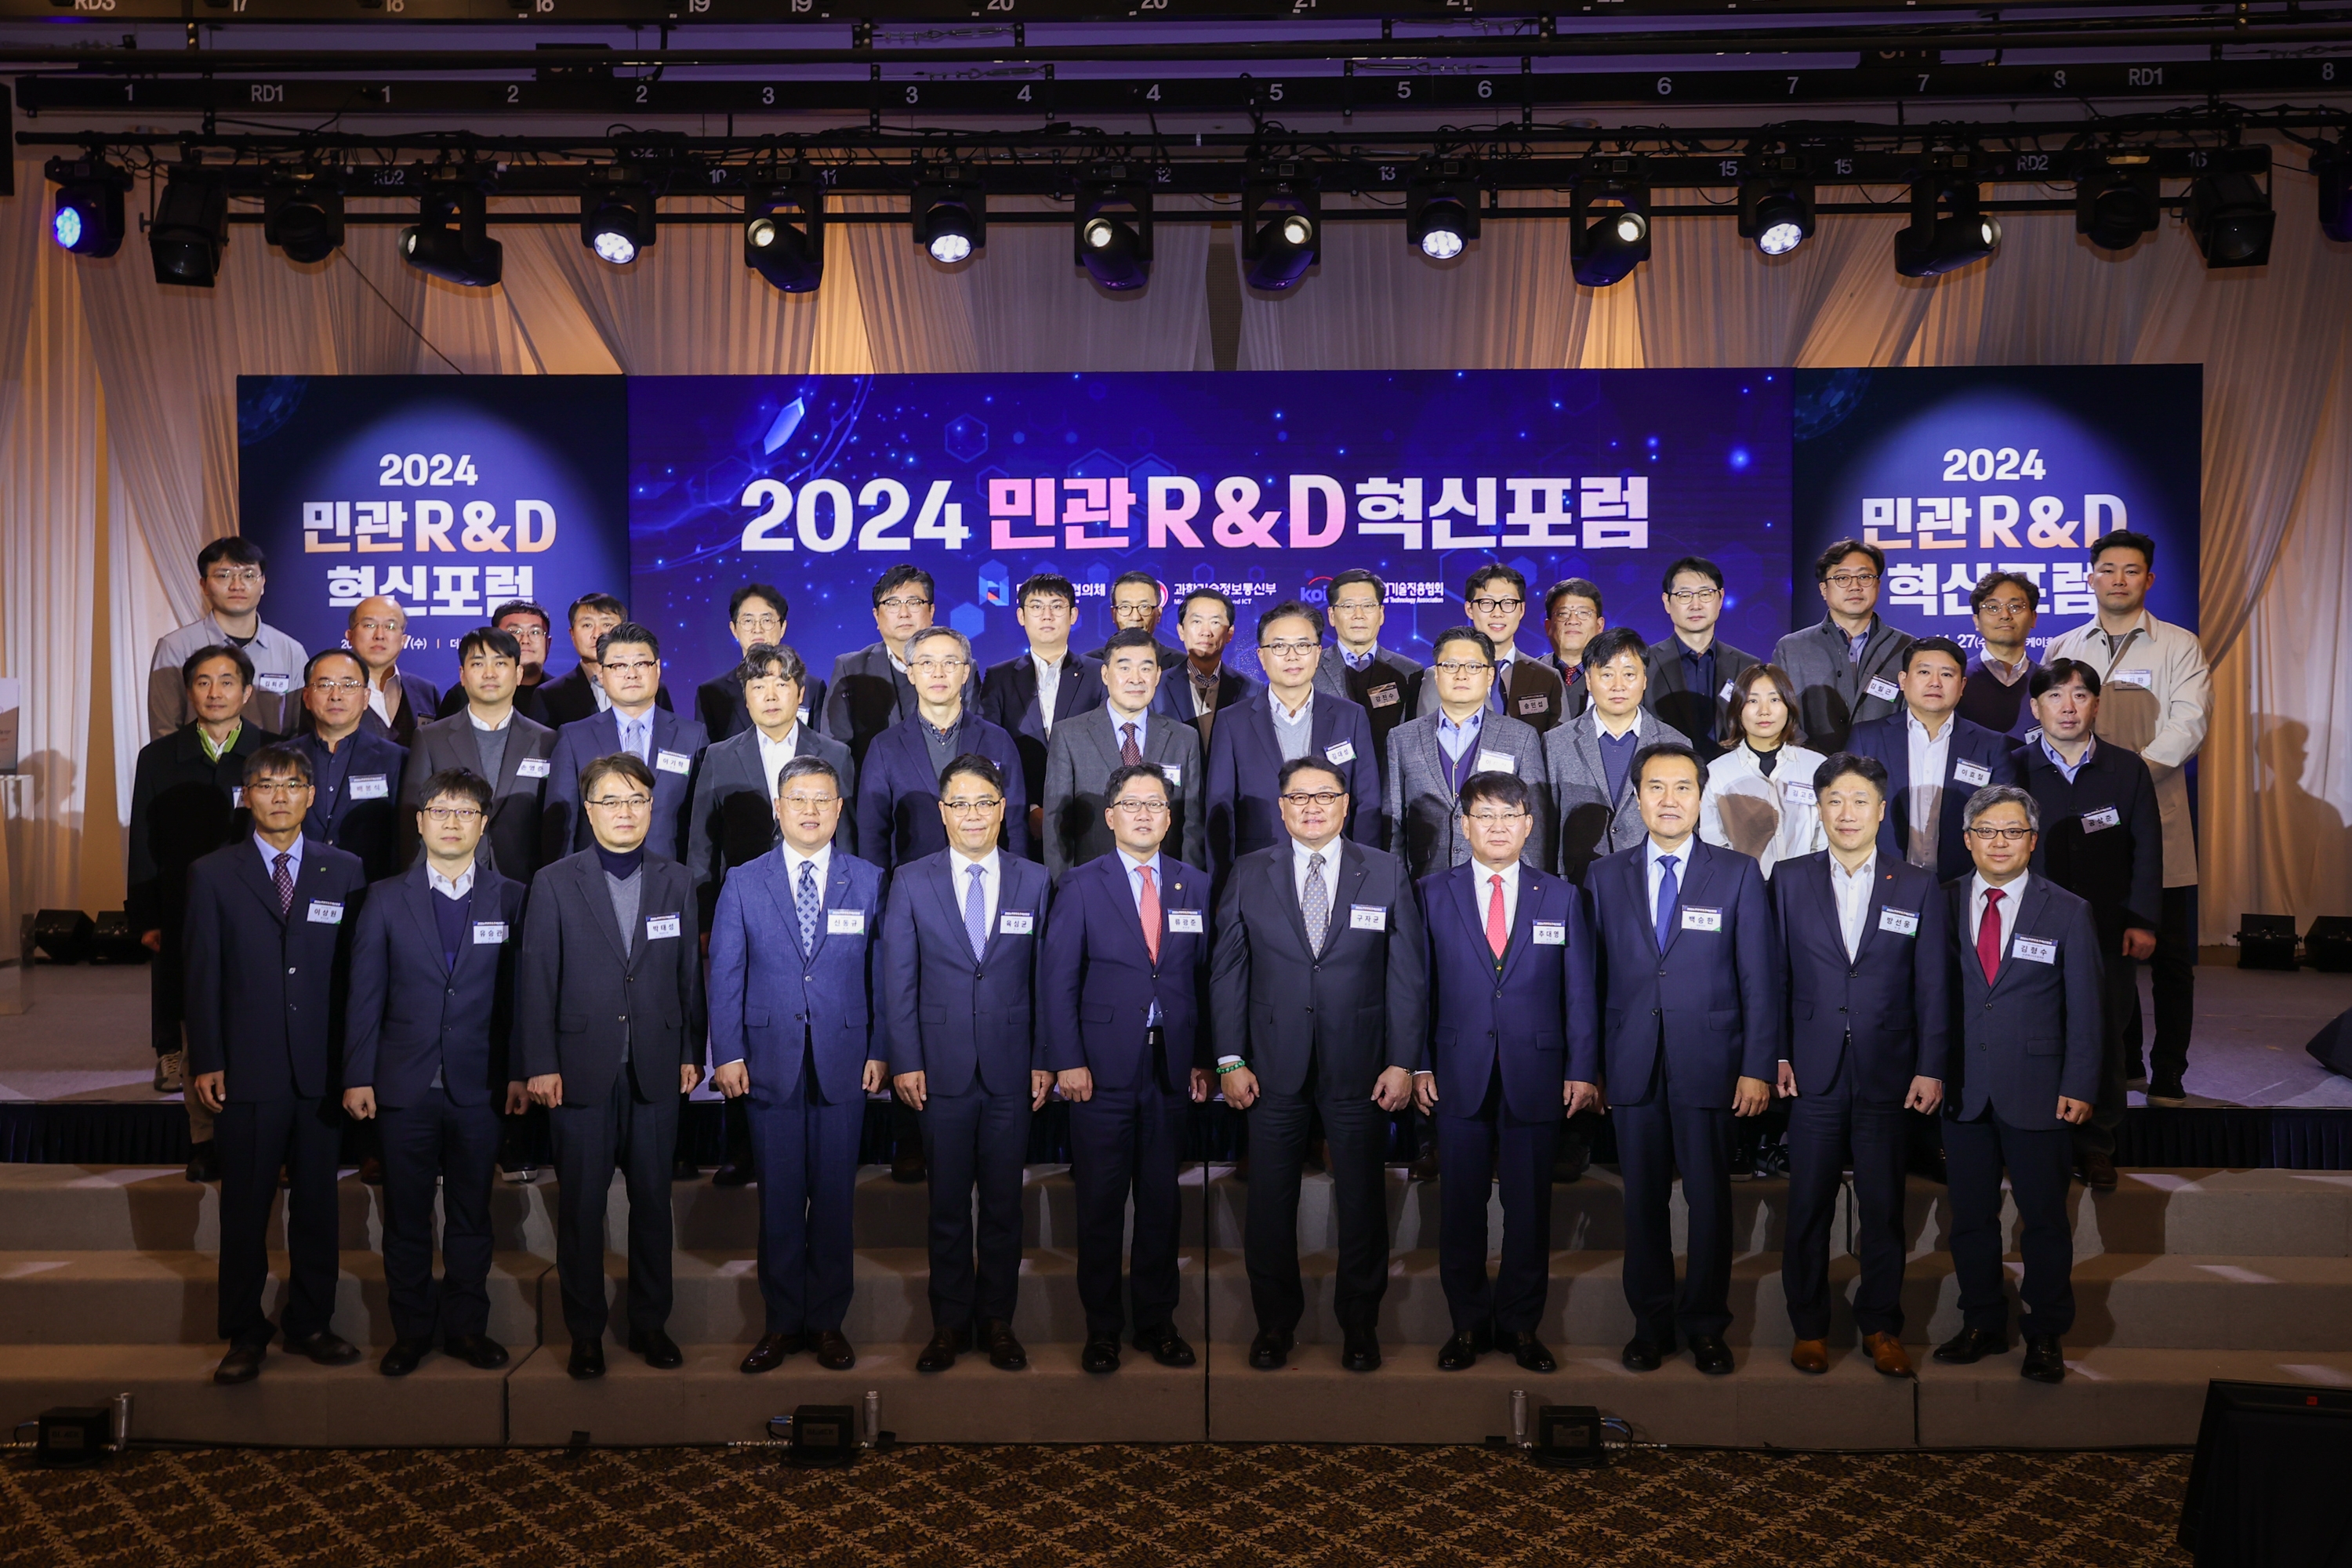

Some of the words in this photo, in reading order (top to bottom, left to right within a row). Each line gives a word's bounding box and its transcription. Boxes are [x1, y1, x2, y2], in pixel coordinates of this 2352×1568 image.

[2129, 67, 2162, 86] RD1
[2322, 62, 2335, 81] 8
[125, 84, 132, 100] 1
[1269, 83, 1283, 101] 5
[1397, 81, 1411, 99] 5
[1478, 80, 1492, 98] 6
[1657, 77, 1672, 95] 6
[1787, 76, 1799, 94] 7
[1918, 74, 1930, 92] 7
[251, 84, 283, 101] RD1
[381, 85, 390, 103] 1
[507, 85, 519, 103] 2
[636, 85, 648, 103] 2
[762, 86, 775, 104] 3
[906, 85, 919, 104] 3
[1017, 85, 1032, 102] 4
[1146, 84, 1161, 101] 4
[1719, 160, 1738, 176] 15
[1834, 158, 1853, 175] 15
[2017, 154, 2048, 171] RD2
[379, 453, 478, 487] 2024
[1943, 447, 2046, 482] 2024
[741, 477, 970, 553] 2024
[989, 477, 1137, 550] 민관
[1147, 474, 1347, 549] R&D
[1356, 476, 1650, 550] 혁신포럼
[1861, 497, 1973, 550] 민관
[1980, 494, 2128, 549] R&D
[303, 501, 408, 554] 민관
[415, 499, 557, 553] R&D
[327, 565, 533, 617] 혁신포럼
[1689, 916, 1714, 925] 백승한
[2020, 945, 2048, 956] 김형수
